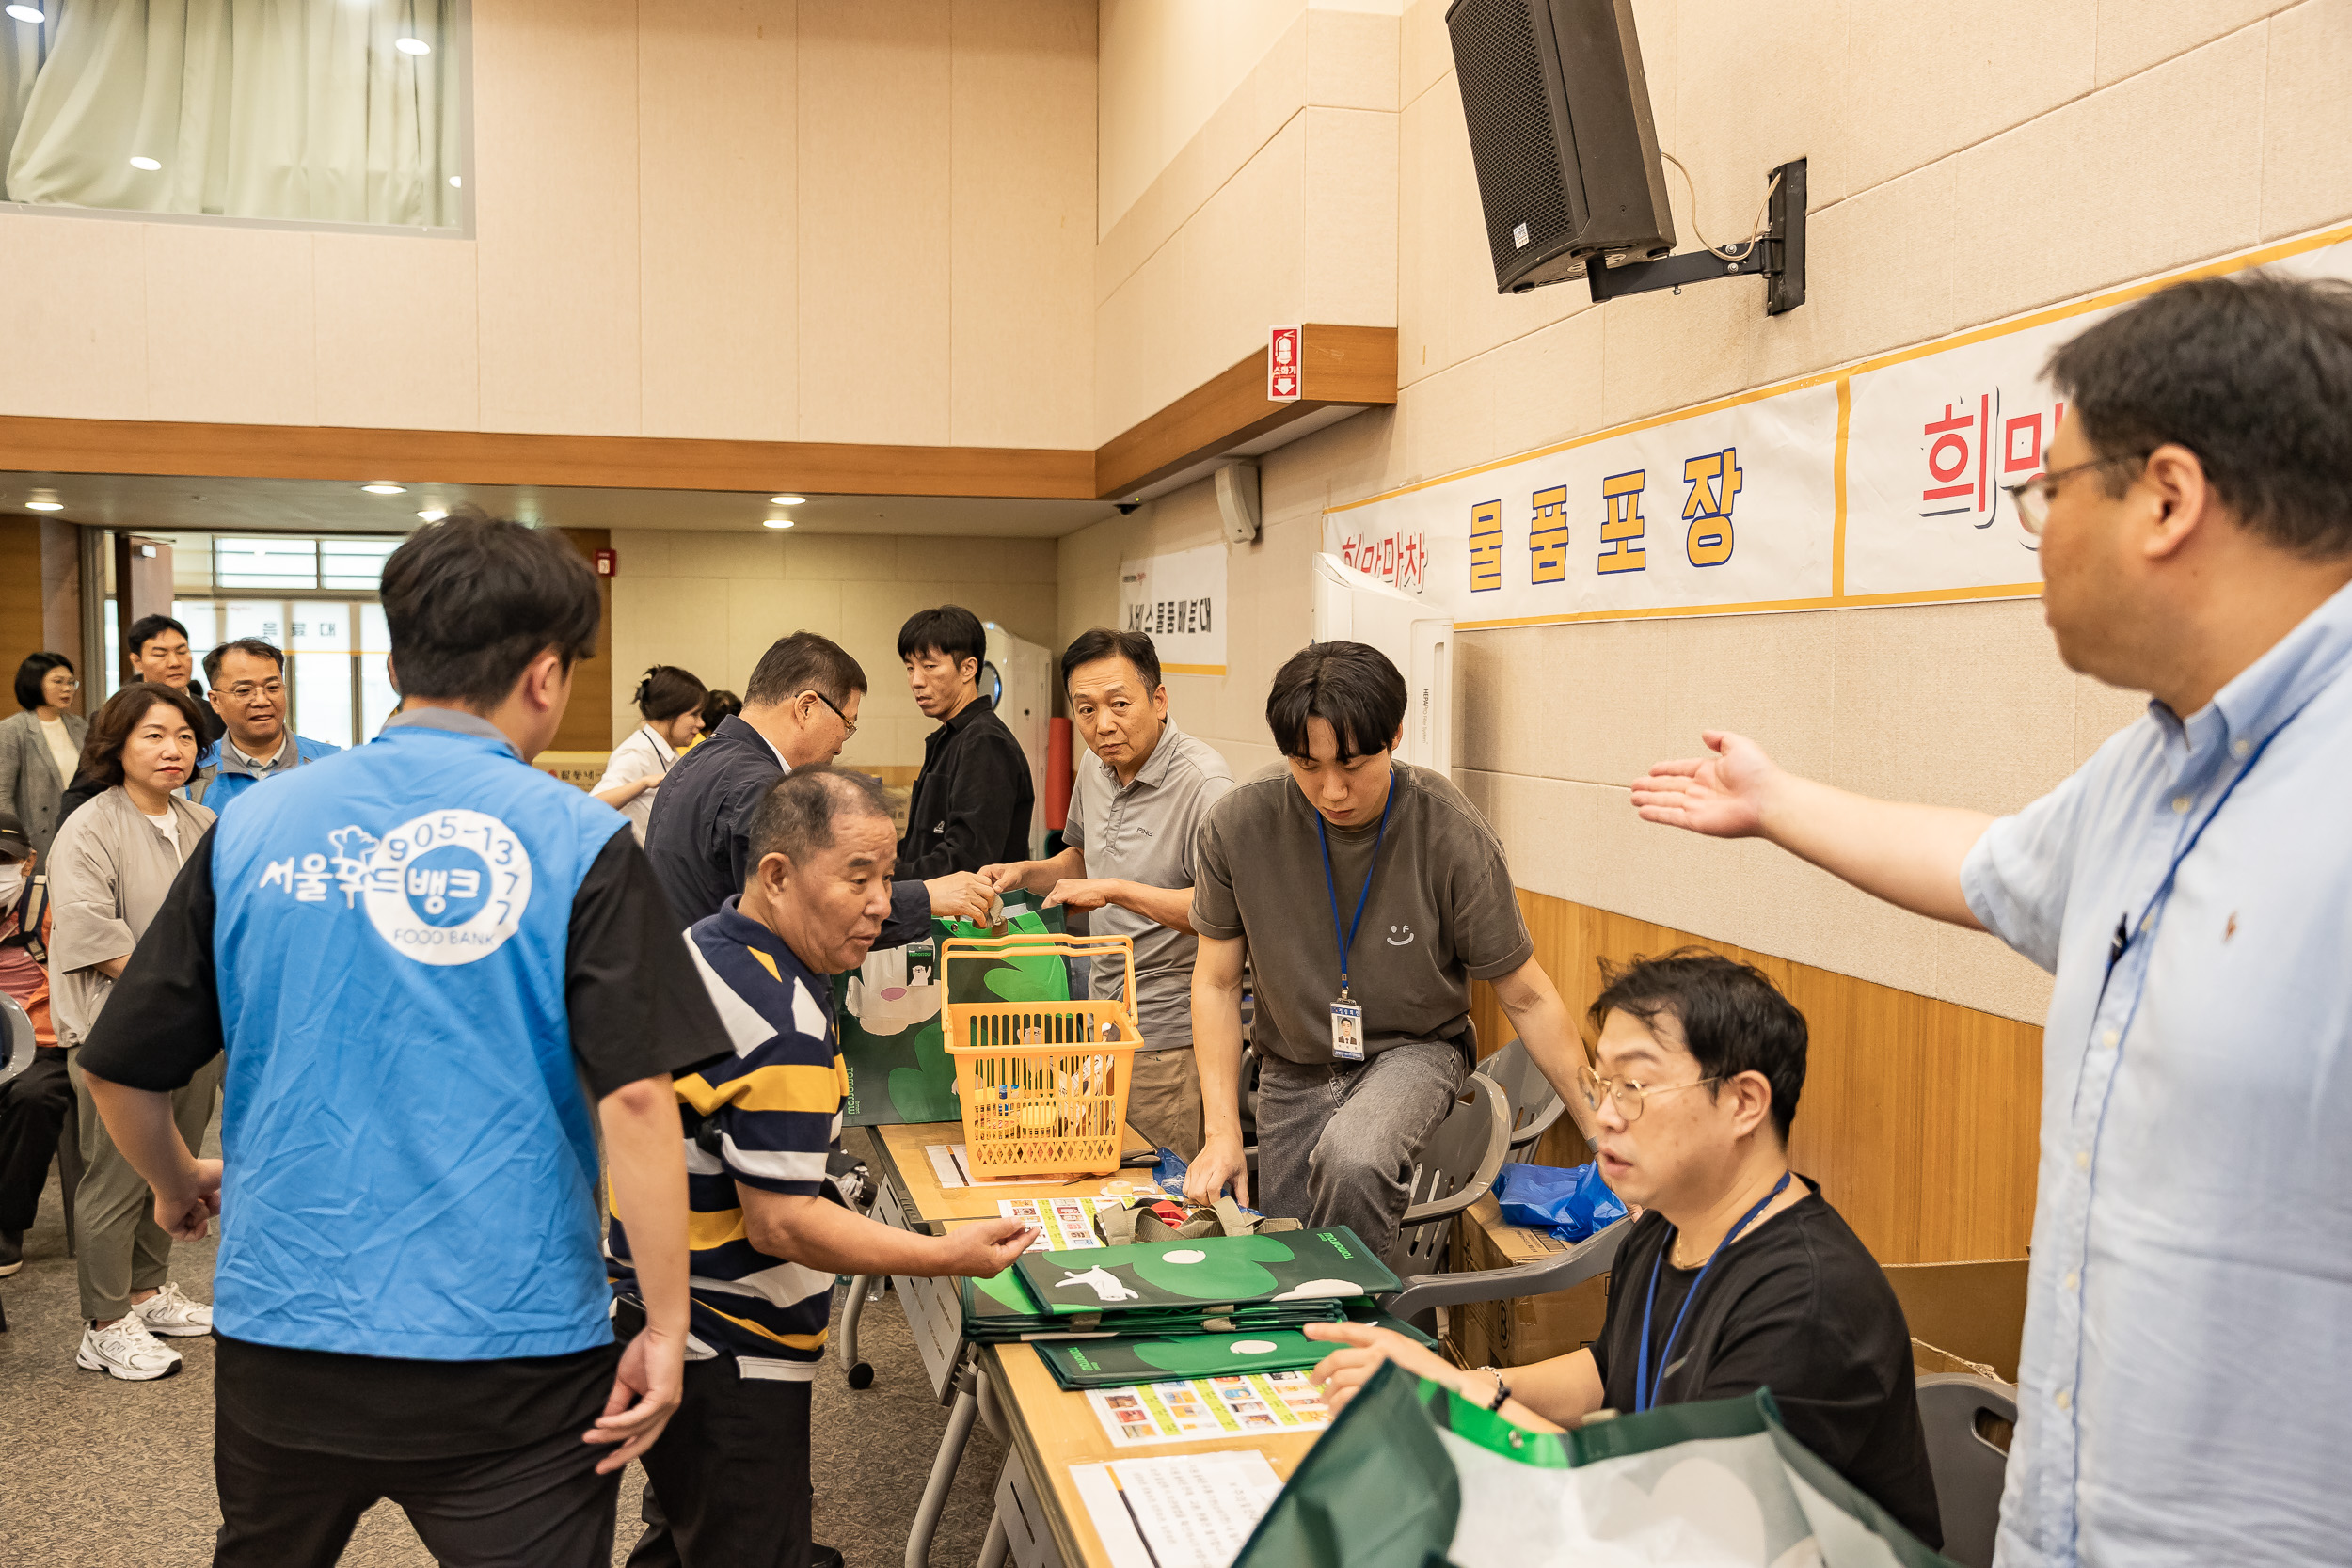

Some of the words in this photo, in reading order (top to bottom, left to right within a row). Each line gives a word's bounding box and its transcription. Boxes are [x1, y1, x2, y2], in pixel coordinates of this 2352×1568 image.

[1273, 365, 1296, 375] 소화기
[1464, 446, 1743, 594] 물품포장
[1136, 827, 1153, 837] PING
[393, 928, 445, 945] FOOD
[449, 928, 496, 947] BANK
